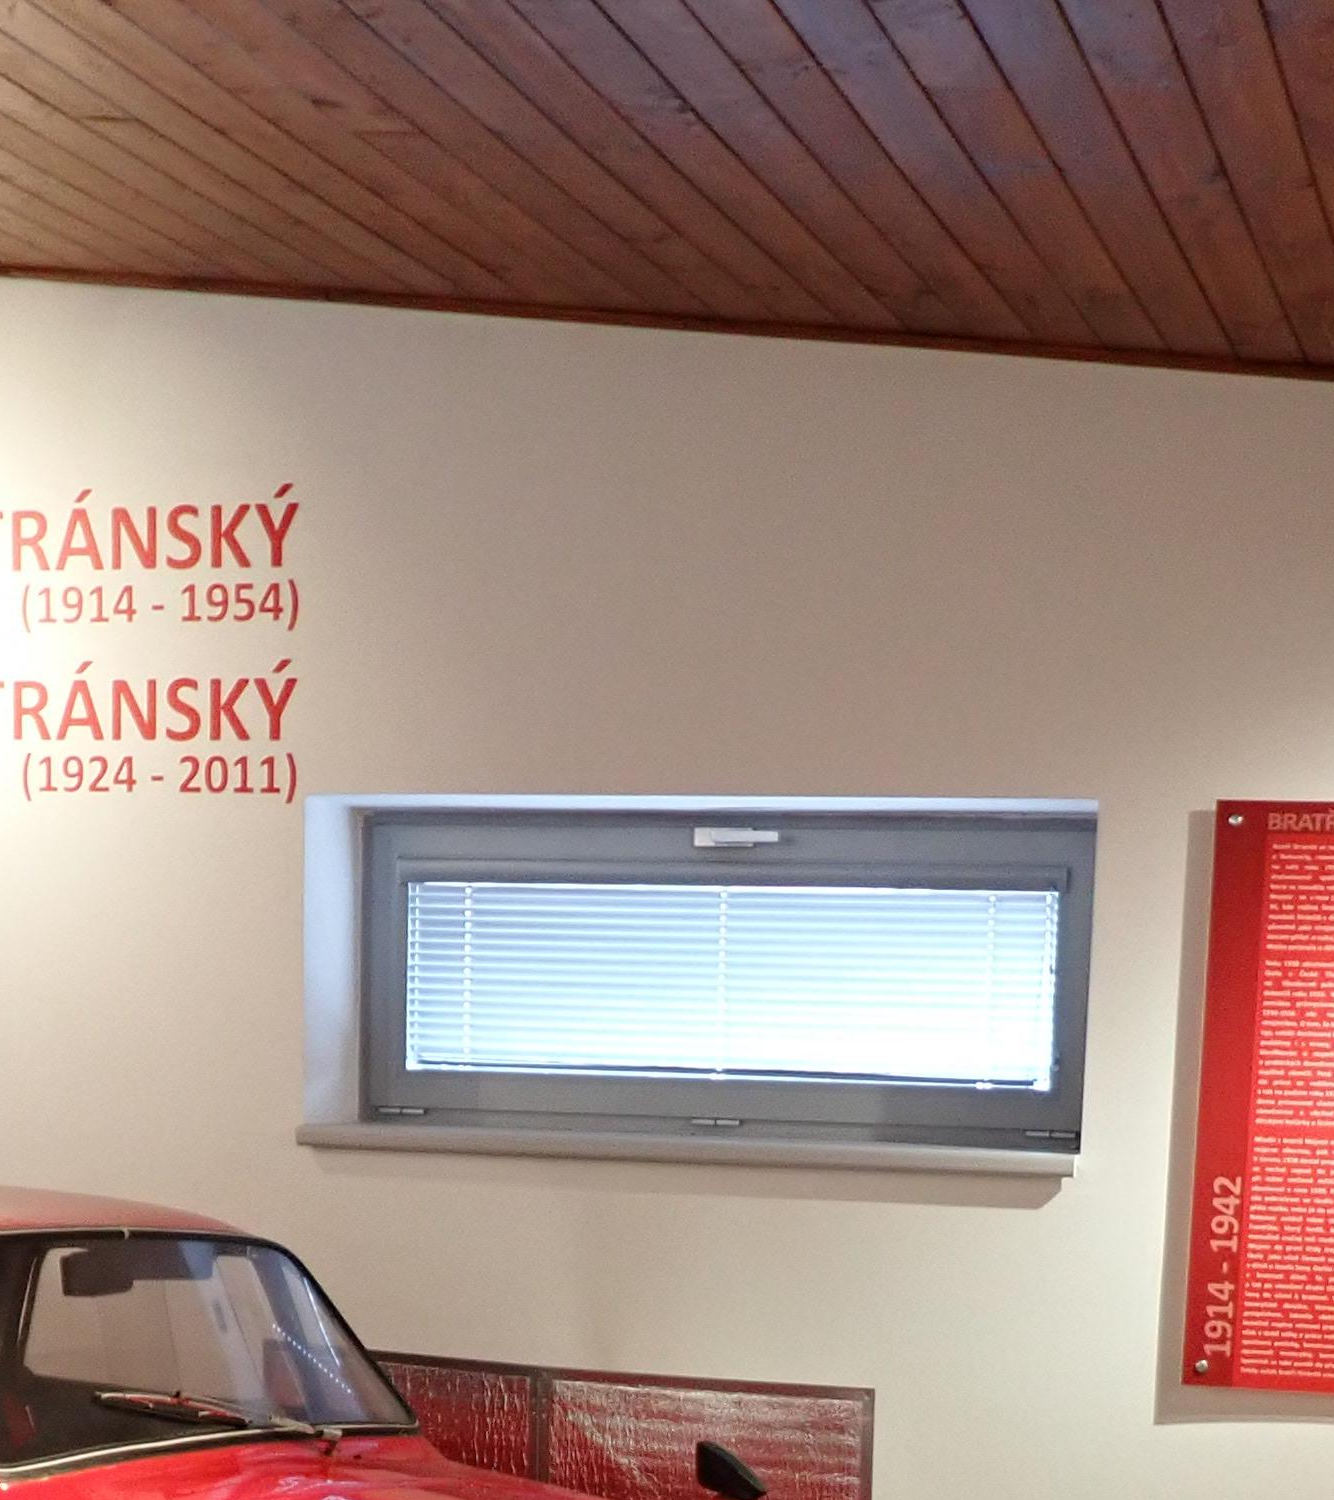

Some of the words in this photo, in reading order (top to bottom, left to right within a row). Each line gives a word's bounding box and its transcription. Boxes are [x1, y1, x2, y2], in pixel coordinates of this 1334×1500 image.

[21, 585, 137, 634] (1914
[179, 579, 299, 632] 1954)
[22, 752, 137, 802] (1924
[178, 753, 299, 804] 2011)
[1212, 1176, 1243, 1254] 1942
[1203, 1281, 1236, 1357] 1914
